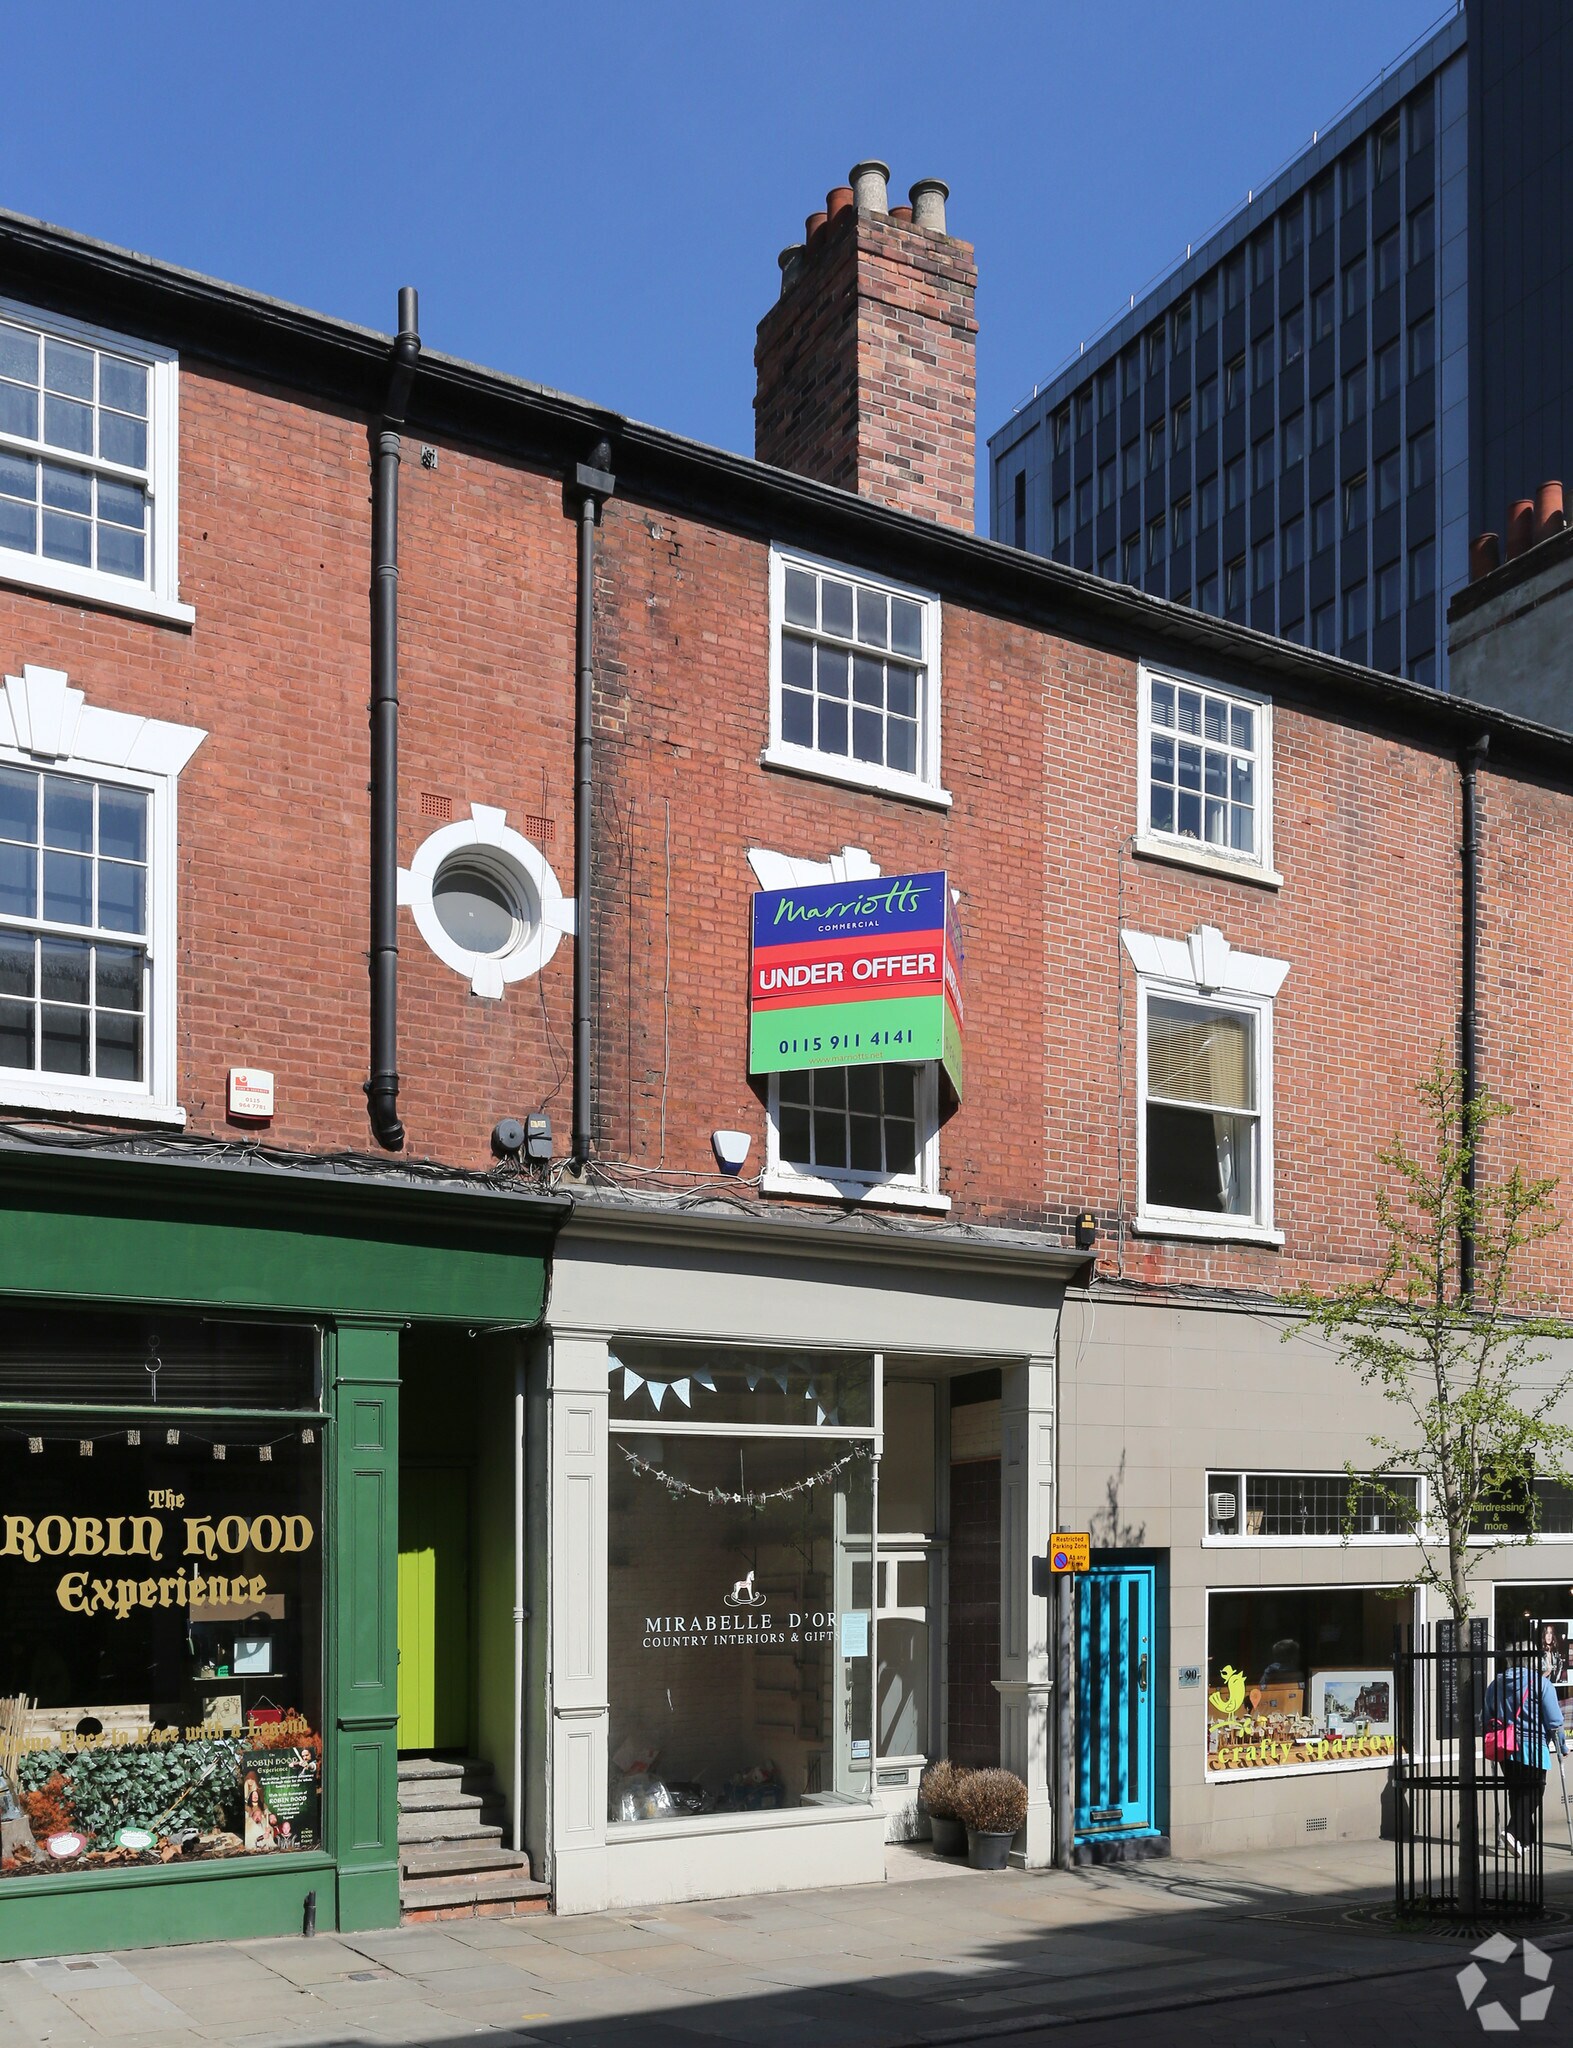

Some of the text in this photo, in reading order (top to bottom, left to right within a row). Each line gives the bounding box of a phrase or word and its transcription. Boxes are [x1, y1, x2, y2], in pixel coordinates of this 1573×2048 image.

[773, 880, 931, 925] Marriotts
[818, 920, 880, 932] COMMERCIAL
[759, 953, 936, 990] UNDER OFFER
[779, 1029, 912, 1054] 0115 911 4141
[149, 1488, 185, 1511] The
[1492, 1513, 1500, 1521] &
[0, 1514, 164, 1563] ROBIN
[56, 1567, 267, 1620] Experience
[645, 1614, 772, 1633] MIRABELLE
[643, 1631, 840, 1648] COUNTRY INTERIORS & GIFTS
[1185, 1669, 1197, 1680] 90
[111, 1728, 129, 1745] to
[137, 1726, 180, 1745] Face
[185, 1719, 224, 1743] with
[231, 1726, 241, 1738] a
[248, 1713, 309, 1738] Legend
[246, 1759, 274, 1767] ROBIN
[1218, 1738, 1293, 1764] crafty
